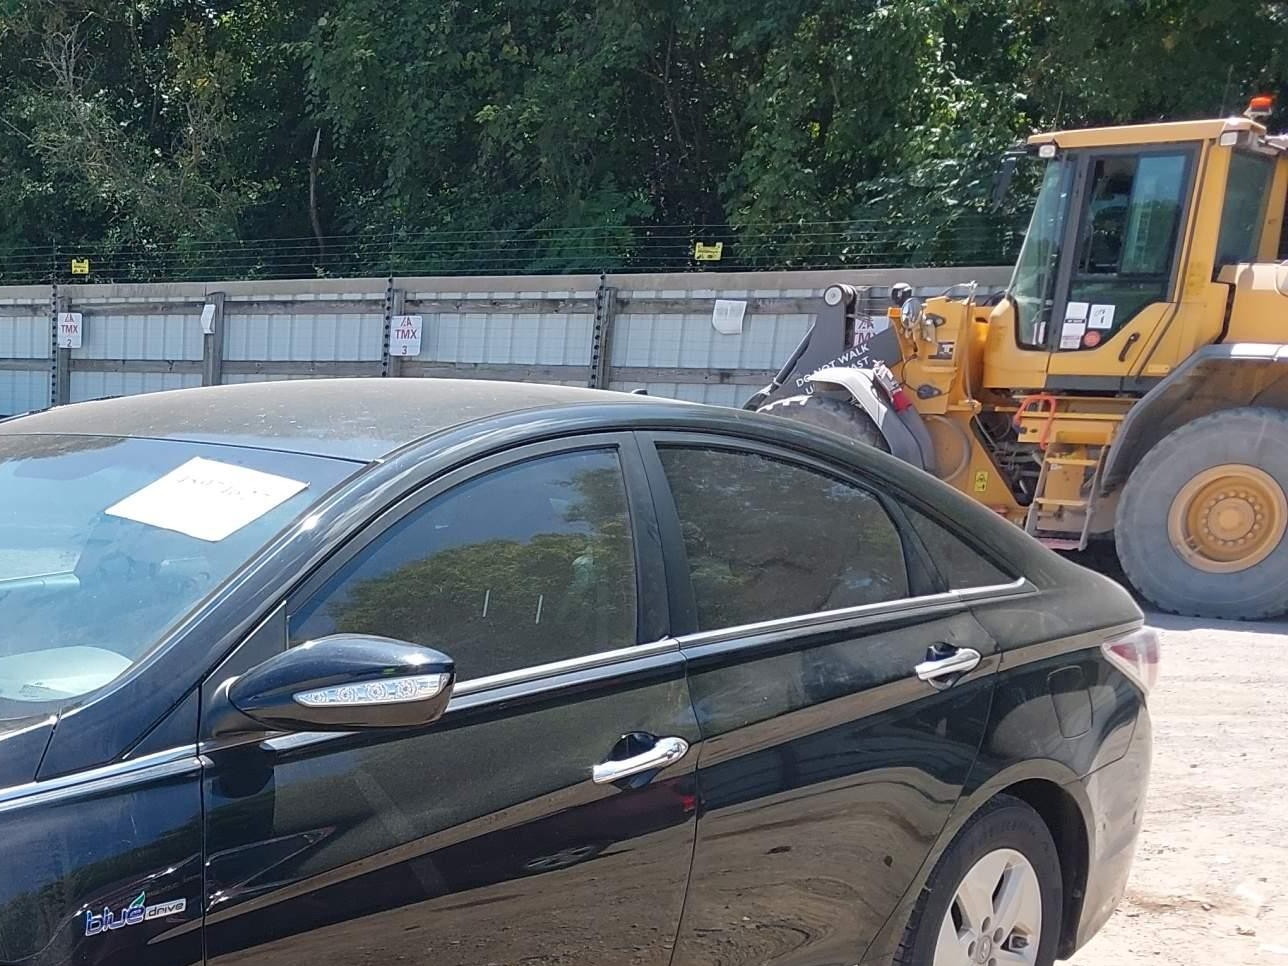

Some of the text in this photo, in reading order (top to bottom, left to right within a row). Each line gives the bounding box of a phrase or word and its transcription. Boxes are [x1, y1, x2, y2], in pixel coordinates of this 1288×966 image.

[61, 325, 78, 334] TMX
[395, 329, 417, 339] TMX
[67, 339, 72, 347] 2
[402, 345, 408, 354] 3
[838, 343, 870, 364] WALK
[85, 901, 184, 936] blue drive
